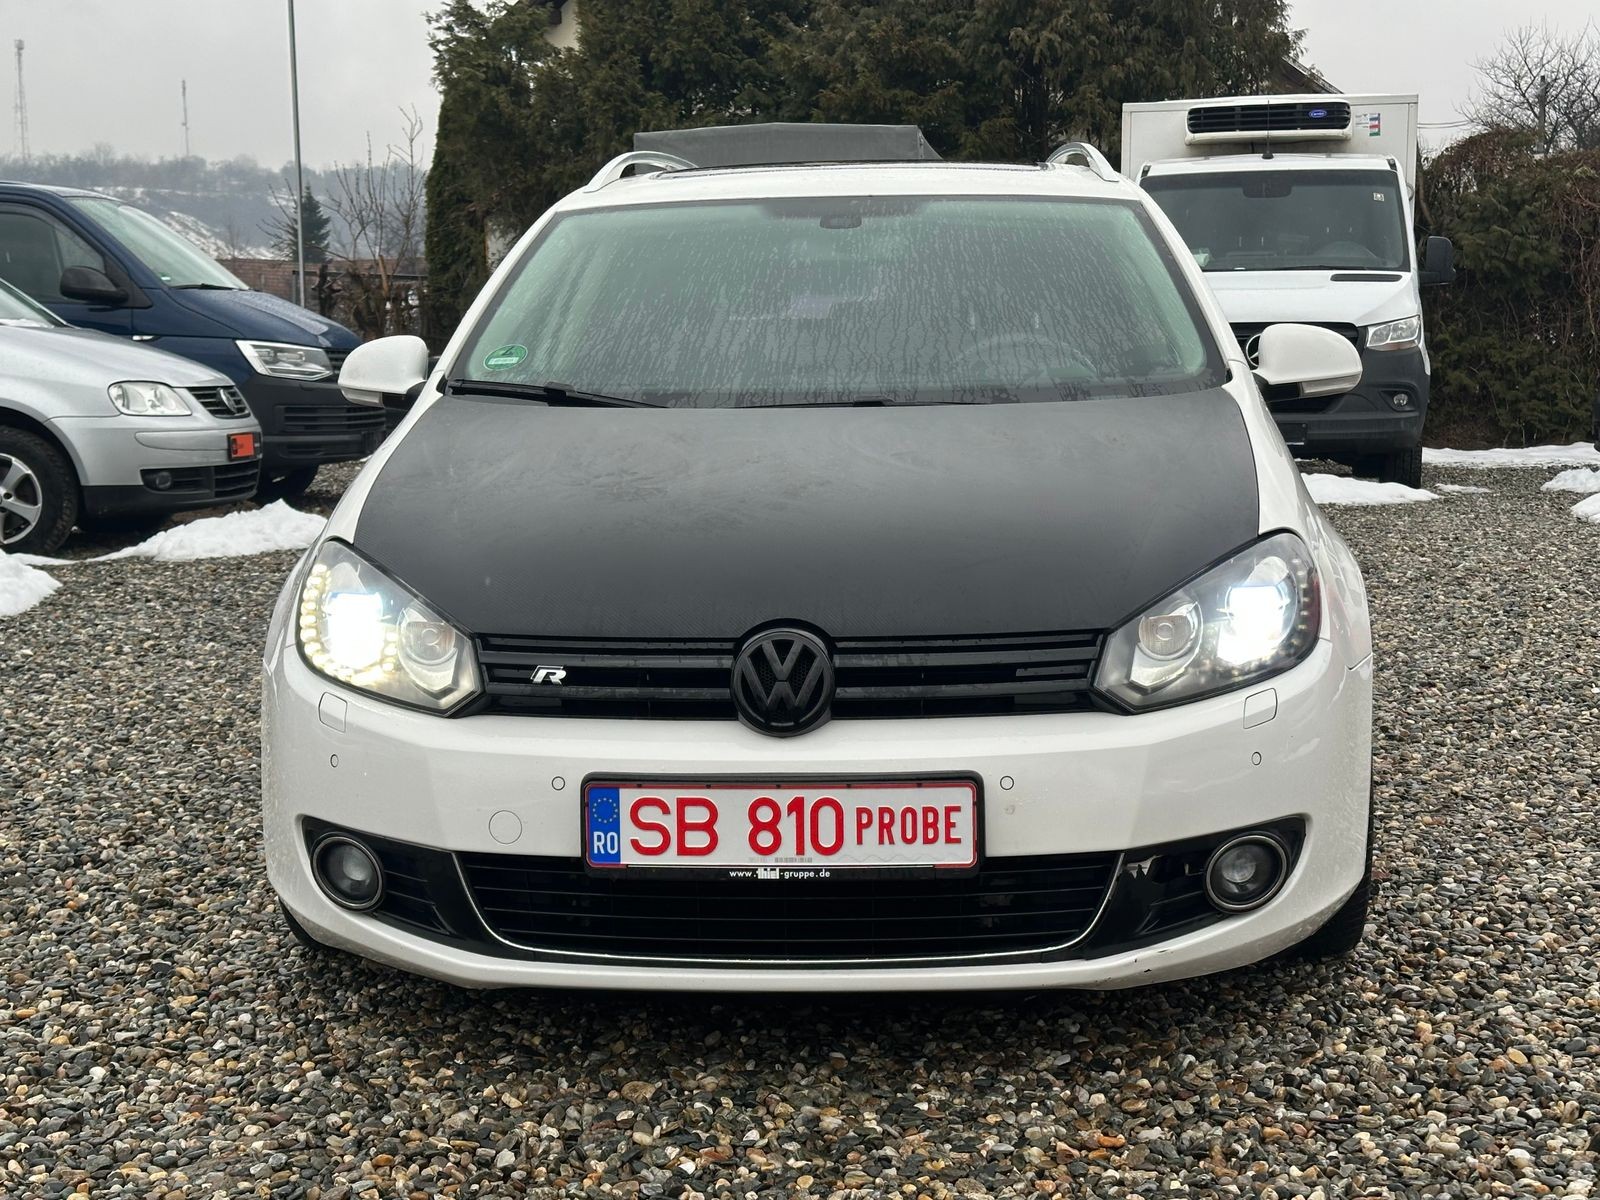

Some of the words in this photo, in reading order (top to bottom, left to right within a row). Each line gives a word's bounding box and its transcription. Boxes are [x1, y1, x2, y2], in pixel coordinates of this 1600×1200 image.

[531, 665, 567, 685] R
[629, 797, 719, 856] SB
[748, 796, 844, 856] 810
[855, 805, 962, 846] PROBE
[593, 831, 619, 854] RO
